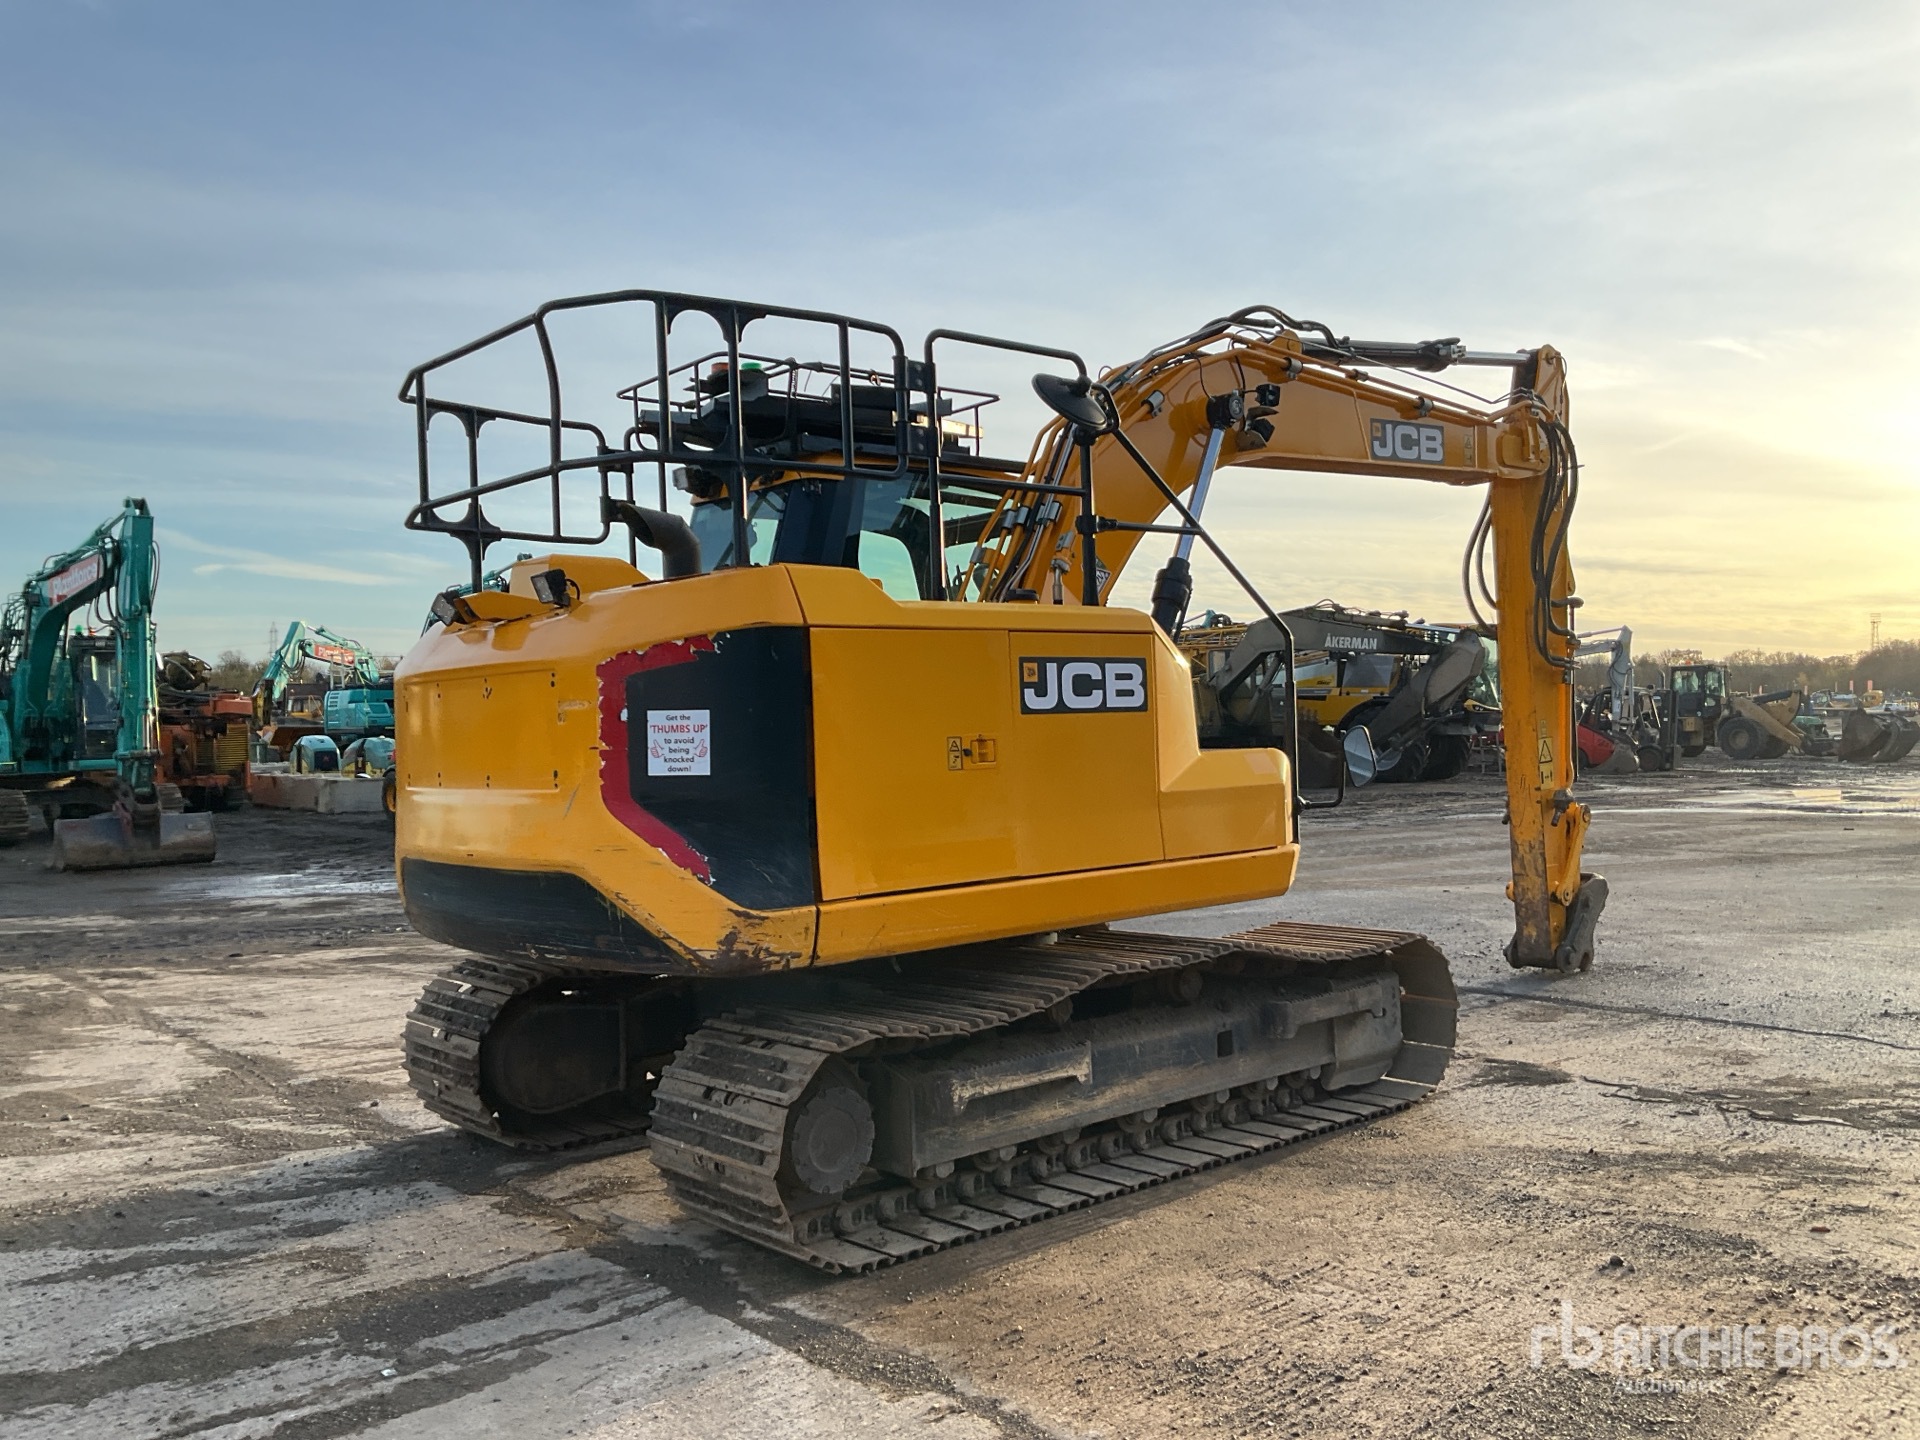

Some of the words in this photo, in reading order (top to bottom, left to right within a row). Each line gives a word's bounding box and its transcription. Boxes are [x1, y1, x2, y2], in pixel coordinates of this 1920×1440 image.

[1373, 423, 1444, 462] JCB
[1023, 662, 1145, 709] JCB
[668, 747, 690, 755] being
